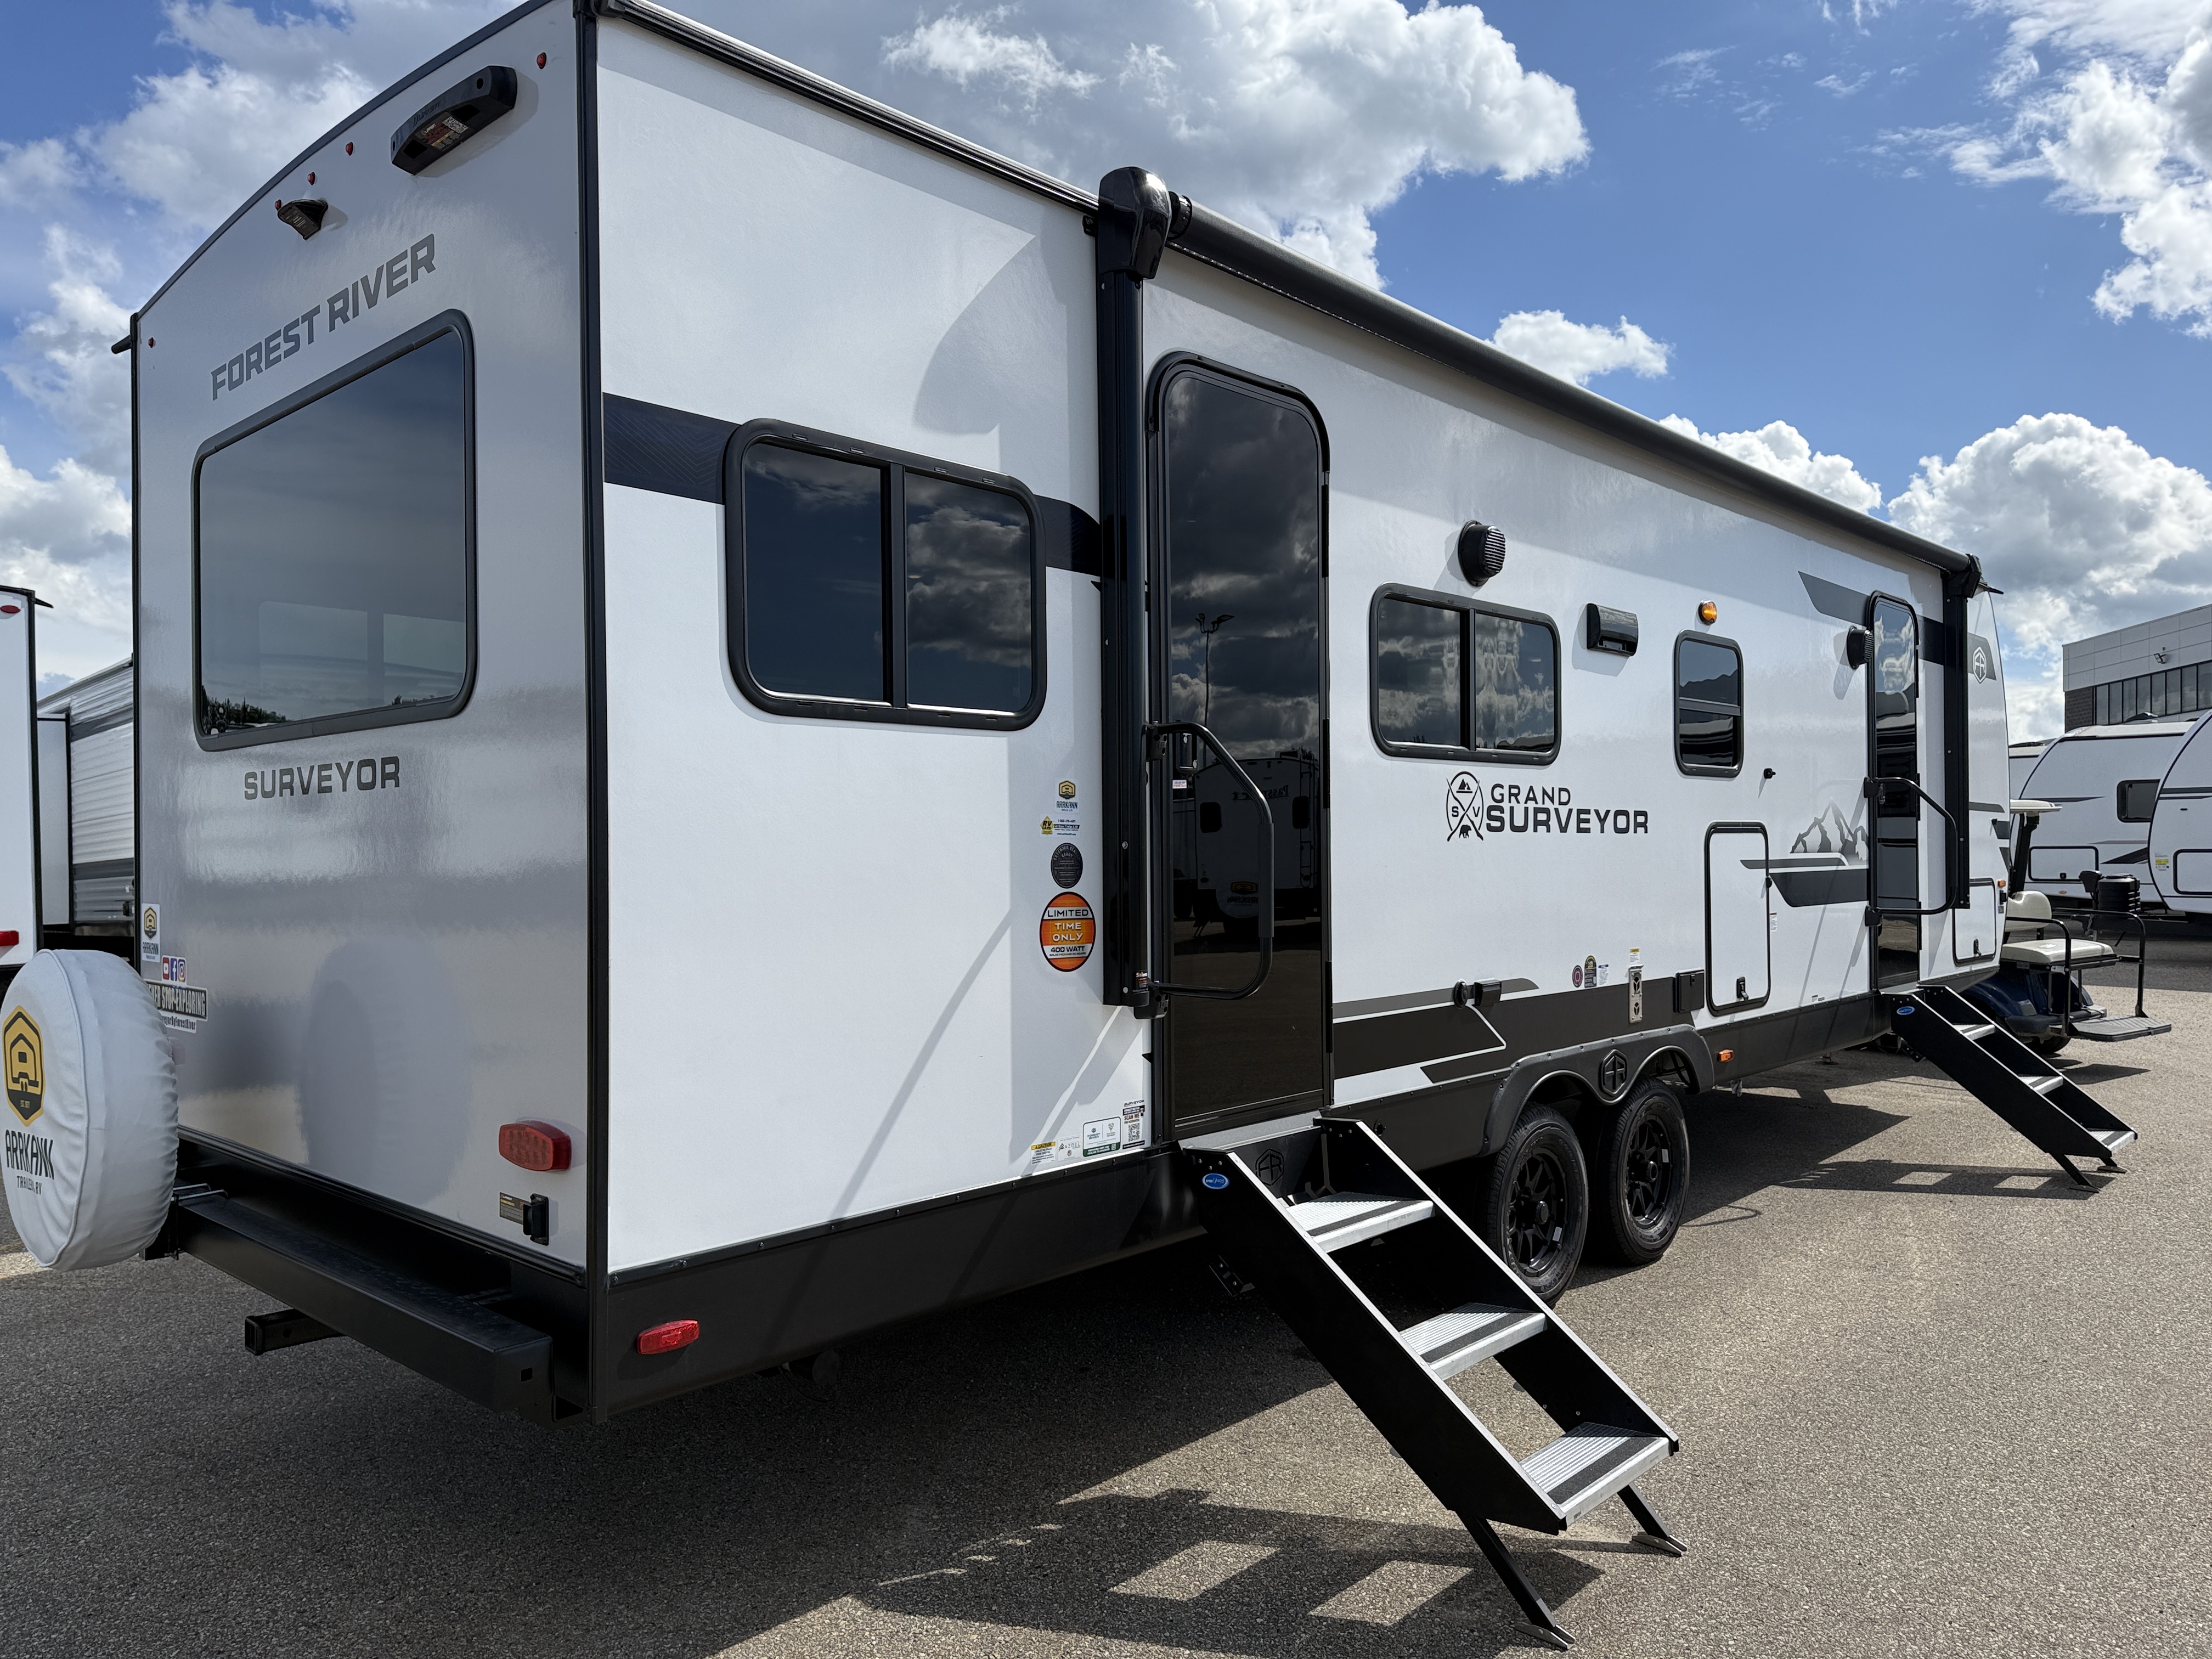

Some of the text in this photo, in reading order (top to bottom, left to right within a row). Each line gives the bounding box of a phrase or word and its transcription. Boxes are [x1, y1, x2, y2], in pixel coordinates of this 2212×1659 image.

[211, 233, 436, 400] FOREST RIVER
[244, 756, 400, 800] SURVEYOR
[1491, 783, 1571, 805] GRAND
[1452, 806, 1480, 817] S V
[1486, 805, 1648, 834] SURVEYOR
[1047, 909, 1088, 917] LIMITED
[1054, 922, 1082, 930] TIME
[1052, 933, 1084, 942] ONLY
[162, 985, 175, 1011] STOP
[175, 988, 206, 1017] EXPLORING
[5, 1129, 55, 1180] ARRKANN
[36, 1182, 42, 1195] RV
